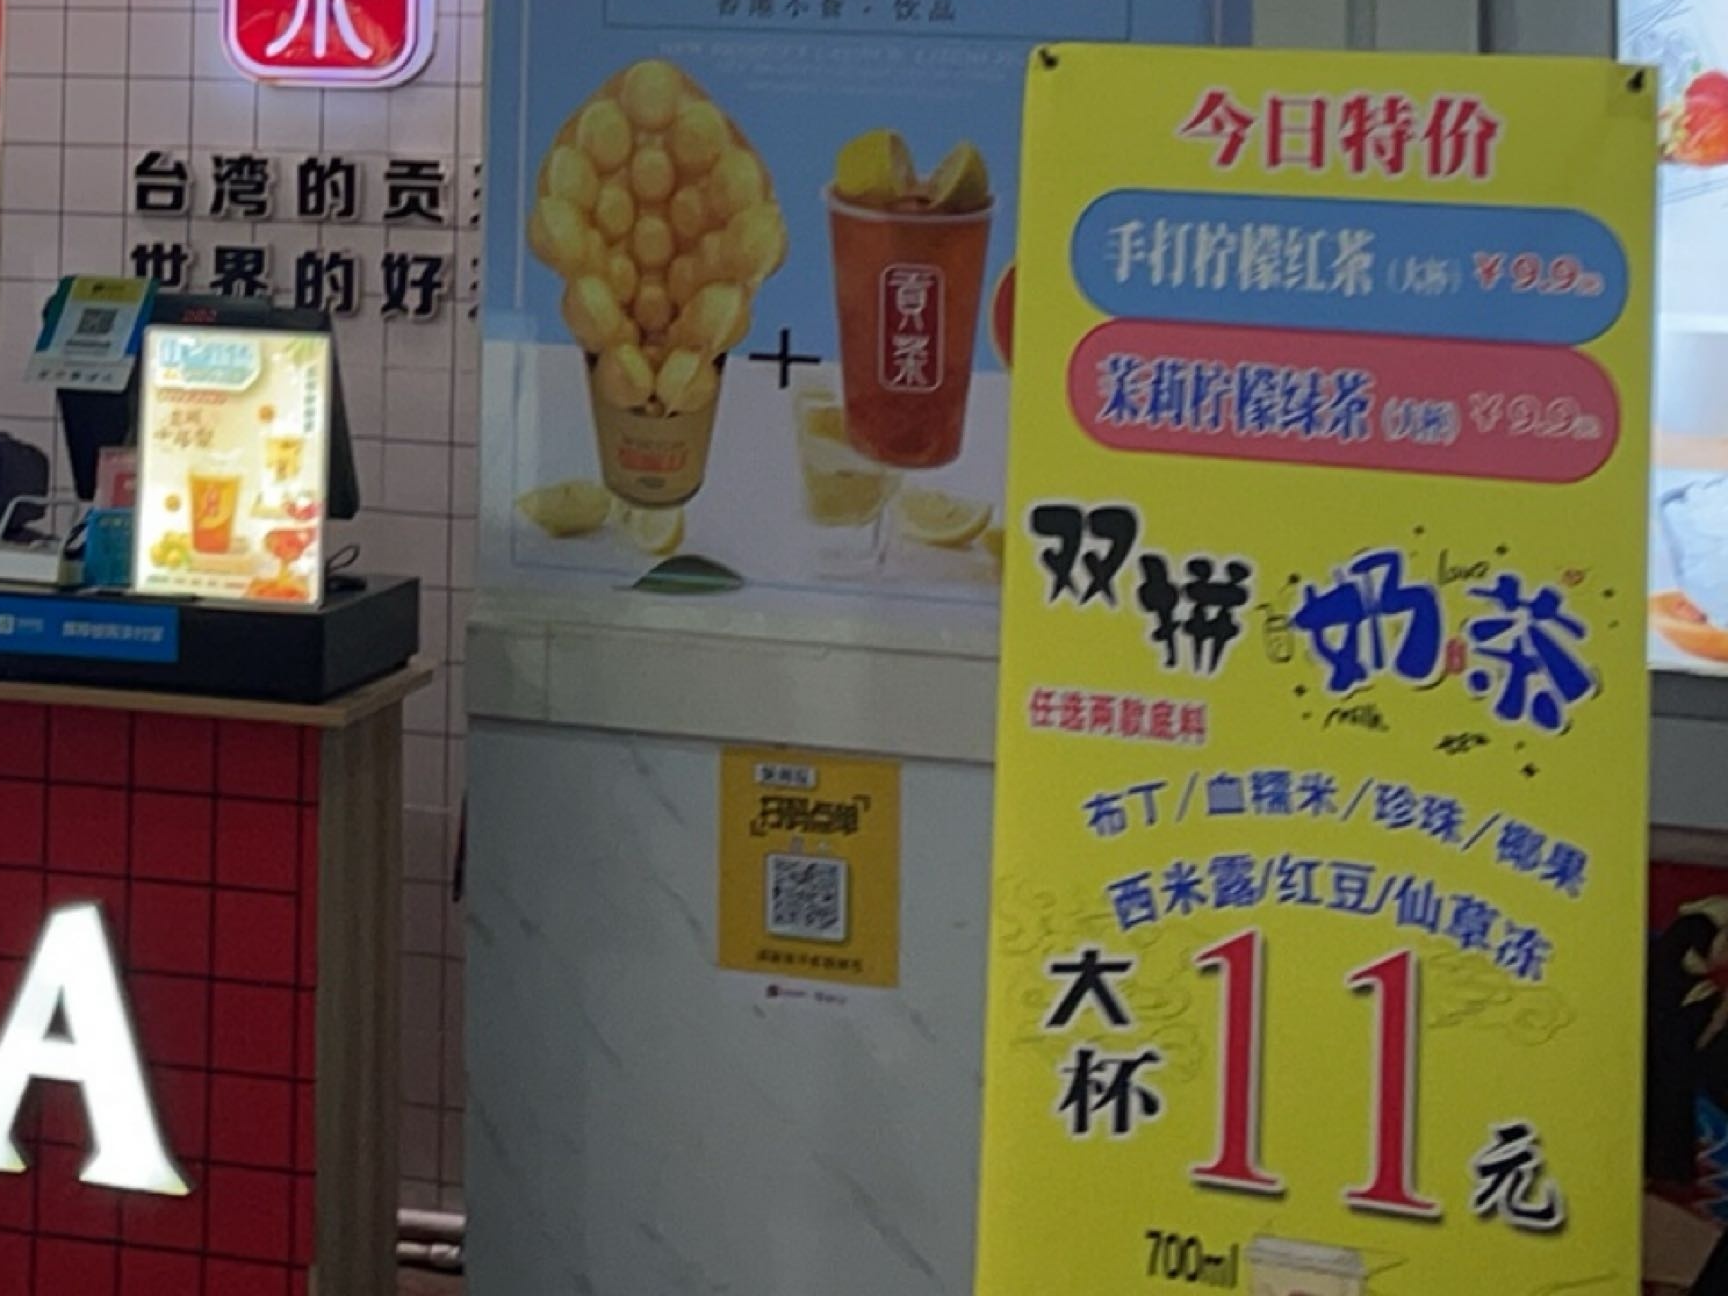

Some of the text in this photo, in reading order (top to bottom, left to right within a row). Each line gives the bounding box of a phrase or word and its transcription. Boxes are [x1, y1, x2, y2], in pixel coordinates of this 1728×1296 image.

[1180, 88, 1500, 179] 今日特价
[132, 150, 482, 224] 台湾的贡
[130, 244, 480, 318] 世界的好
[1109, 219, 1375, 296] 手打柠檬红茶
[1097, 354, 1371, 444] 茉莉柠檬绿茶
[1030, 504, 1252, 674] 双拼
[1289, 551, 1597, 731] 奶茶
[1044, 929, 1564, 1226] 大杯 11 元
[1145, 1231, 1239, 1288] 700ml
